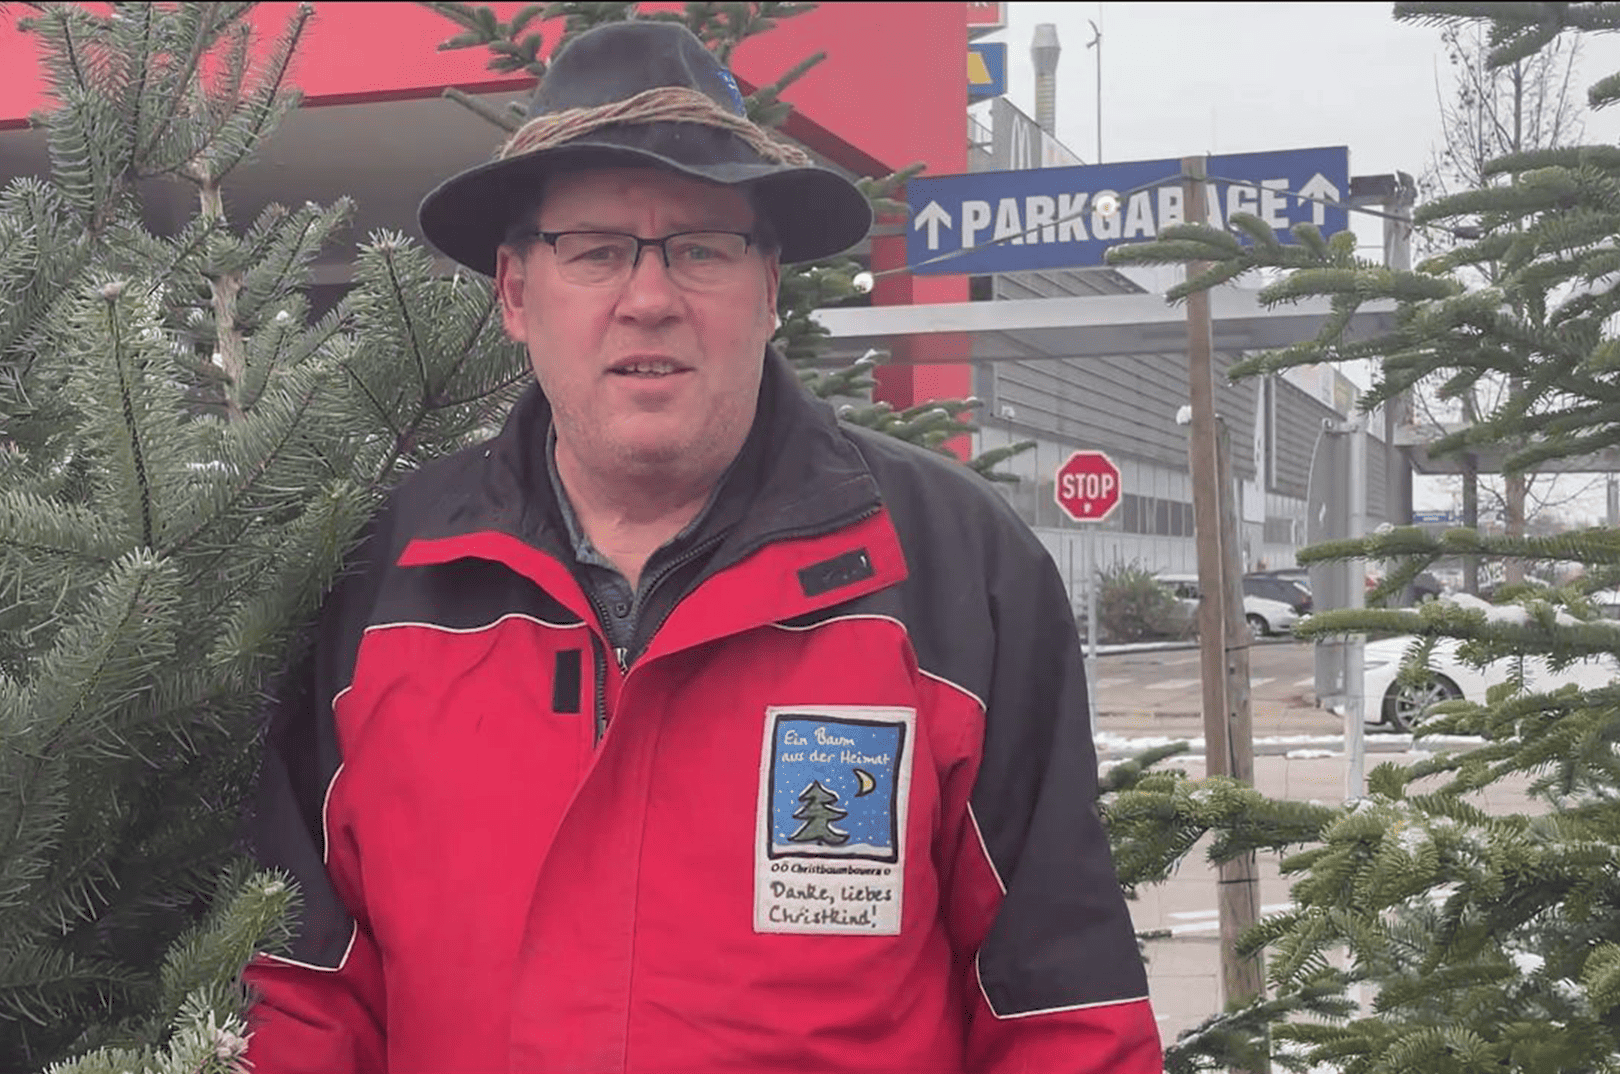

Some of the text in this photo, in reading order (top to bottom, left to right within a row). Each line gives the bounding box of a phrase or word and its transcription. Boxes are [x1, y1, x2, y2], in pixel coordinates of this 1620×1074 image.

[1062, 473, 1114, 499] STOP
[784, 726, 855, 746] Ein Baum
[782, 750, 891, 764] aus der Heimat
[770, 881, 892, 904] Danke, liebes
[769, 904, 877, 928] Christkind!
